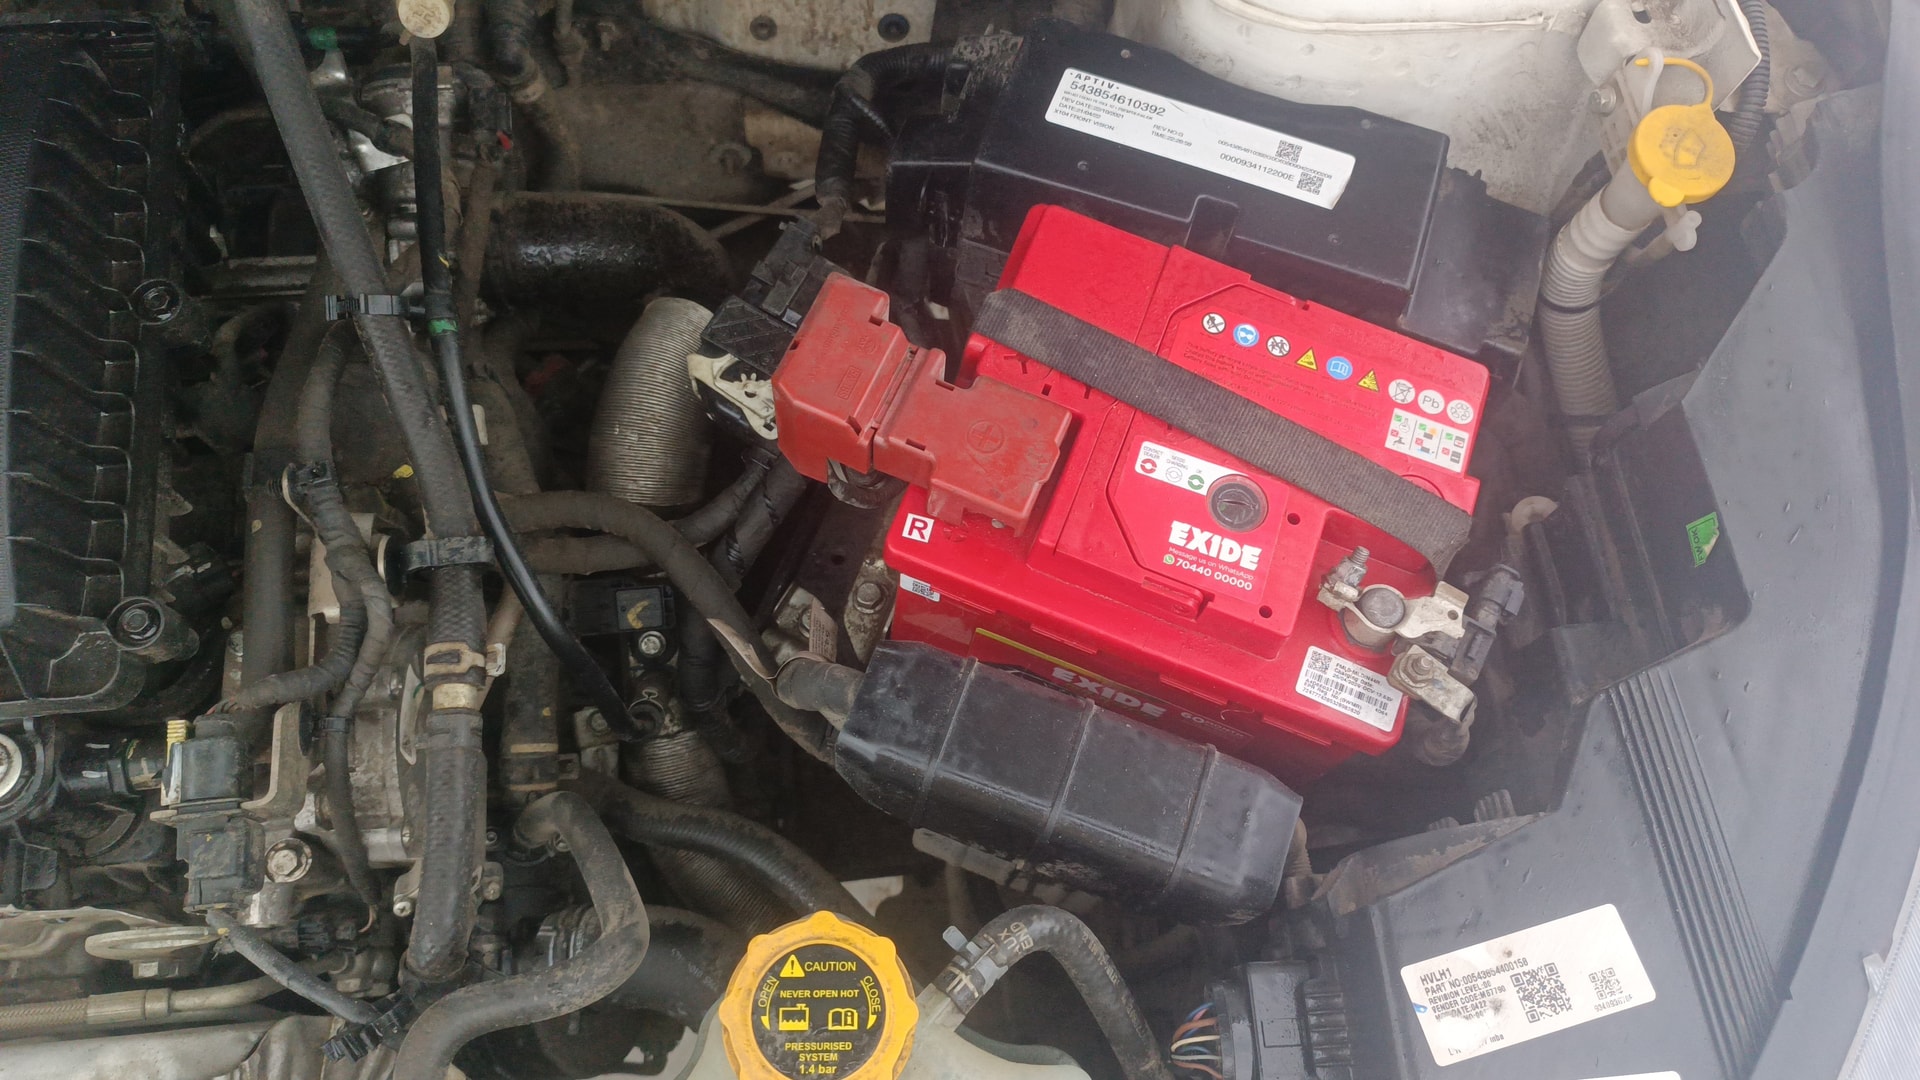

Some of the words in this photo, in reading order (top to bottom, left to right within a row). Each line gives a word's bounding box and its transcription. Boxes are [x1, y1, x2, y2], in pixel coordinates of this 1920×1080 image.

[1073, 72, 1115, 89] APTIV
[1069, 81, 1166, 116] 543854610392
[1069, 113, 1091, 123] FRONT
[1422, 395, 1440, 410] Pb
[908, 517, 929, 540] R
[1168, 520, 1262, 571] EXIDE
[1168, 547, 1198, 562] Message
[1218, 563, 1254, 581] WhatsApp
[1176, 558, 1212, 577] 70440
[1214, 572, 1253, 591] 00000
[1051, 666, 1168, 720] EXIDE
[1010, 921, 1034, 951] END
[805, 962, 856, 971] CAUTION
[1419, 967, 1452, 985] HVLH1
[758, 976, 777, 1007] OPEN
[780, 990, 810, 998] NEVER
[813, 990, 839, 998] OPEN
[841, 990, 859, 998] HOT
[863, 976, 881, 1013] CLOSE
[1424, 983, 1451, 996] PART
[1428, 989, 1460, 1004] REVISION
[1431, 998, 1459, 1013] VENDER
[785, 1042, 852, 1050] PRESSURISED
[799, 1053, 838, 1061] SYSTEM
[799, 1065, 815, 1074] 1.4
[818, 1065, 837, 1074] bar
